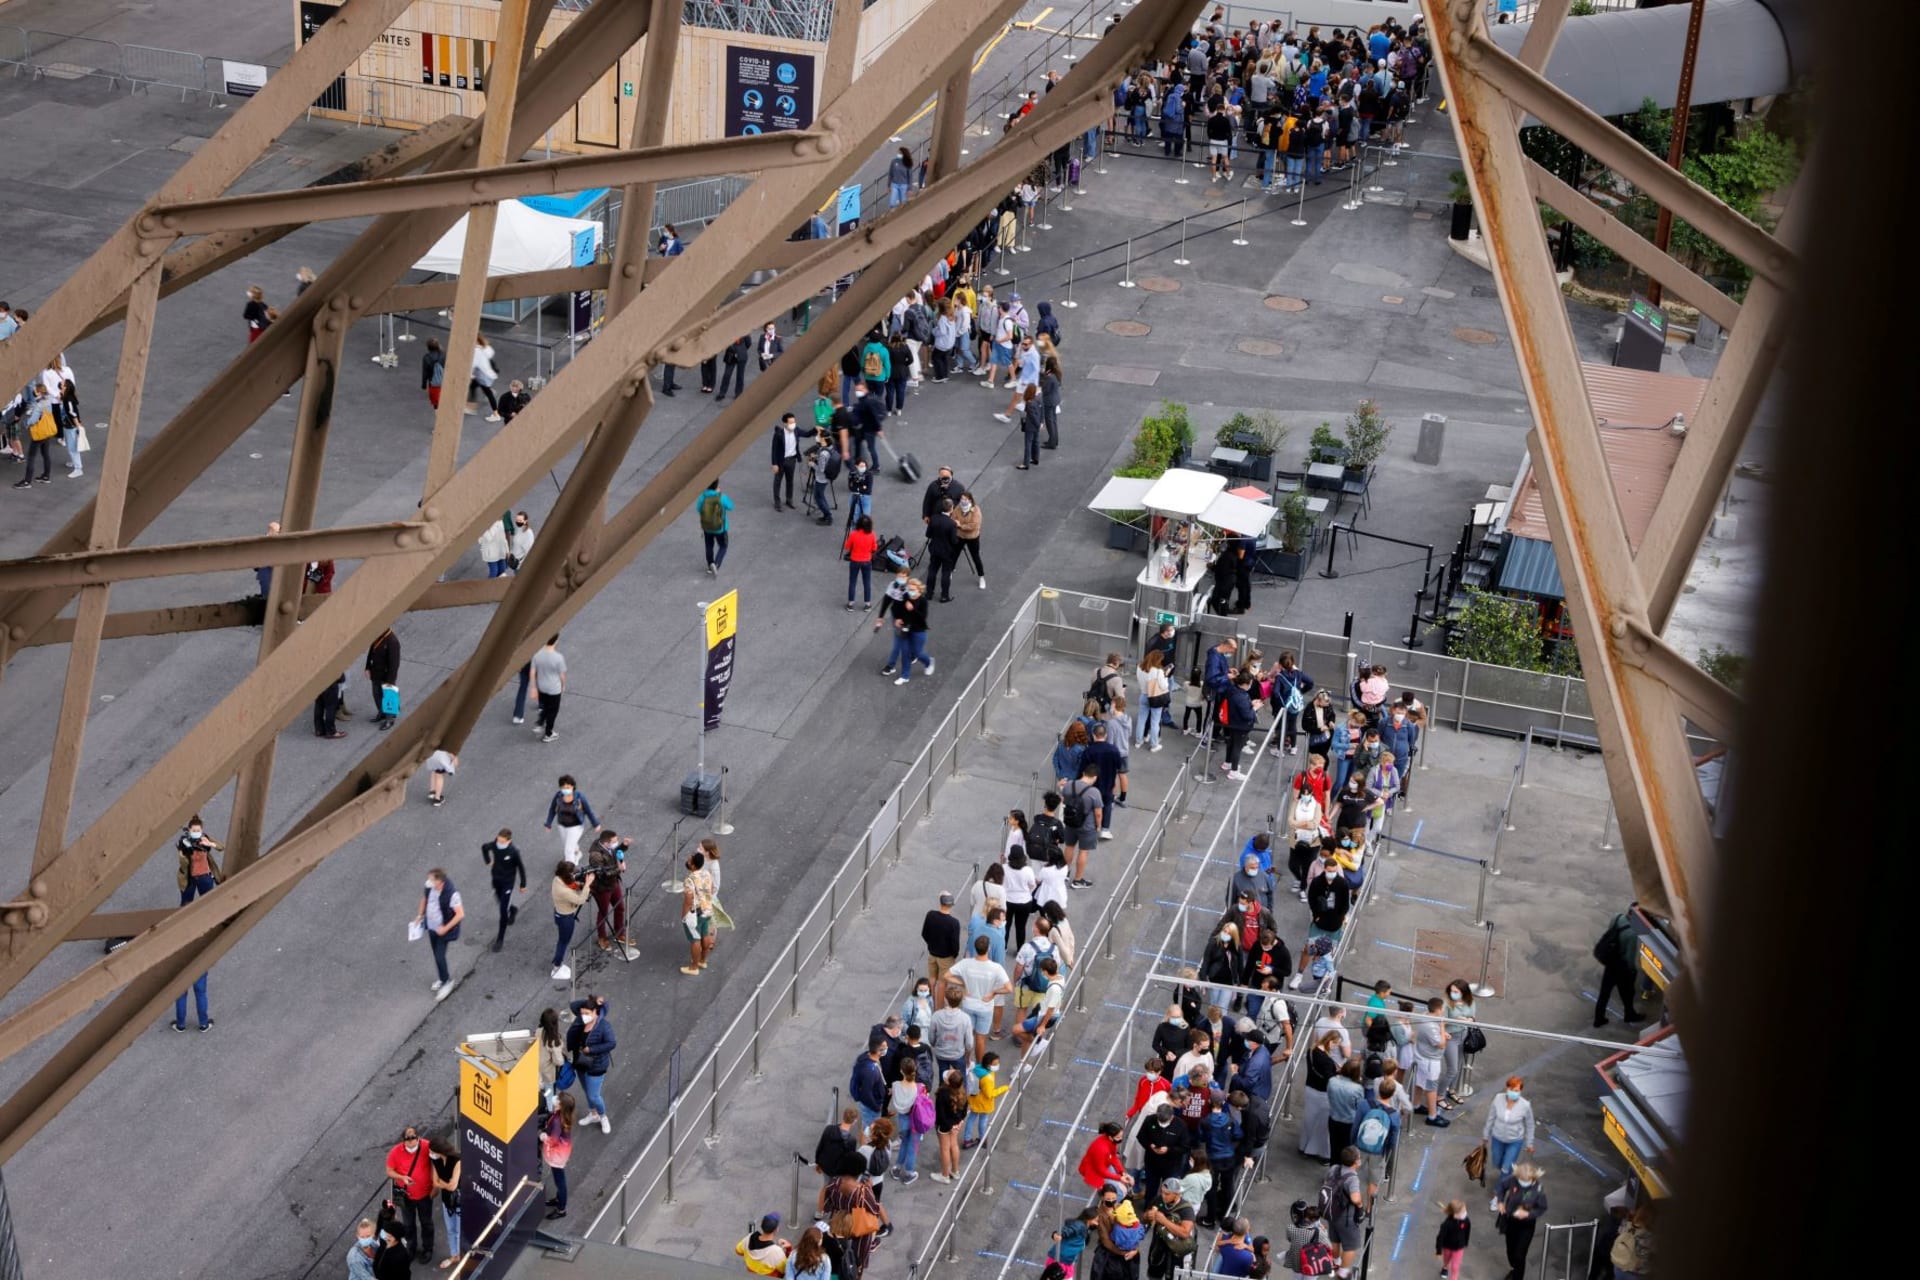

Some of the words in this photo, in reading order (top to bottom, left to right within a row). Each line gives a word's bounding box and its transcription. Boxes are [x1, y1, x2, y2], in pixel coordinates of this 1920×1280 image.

[375, 34, 411, 46] INTES
[739, 56, 770, 66] COVID-19
[466, 1129, 503, 1164] CAISSE
[480, 1160, 503, 1181] TICKET
[480, 1170, 503, 1192] OFFICE
[472, 1181, 503, 1208] TAQUILLA
